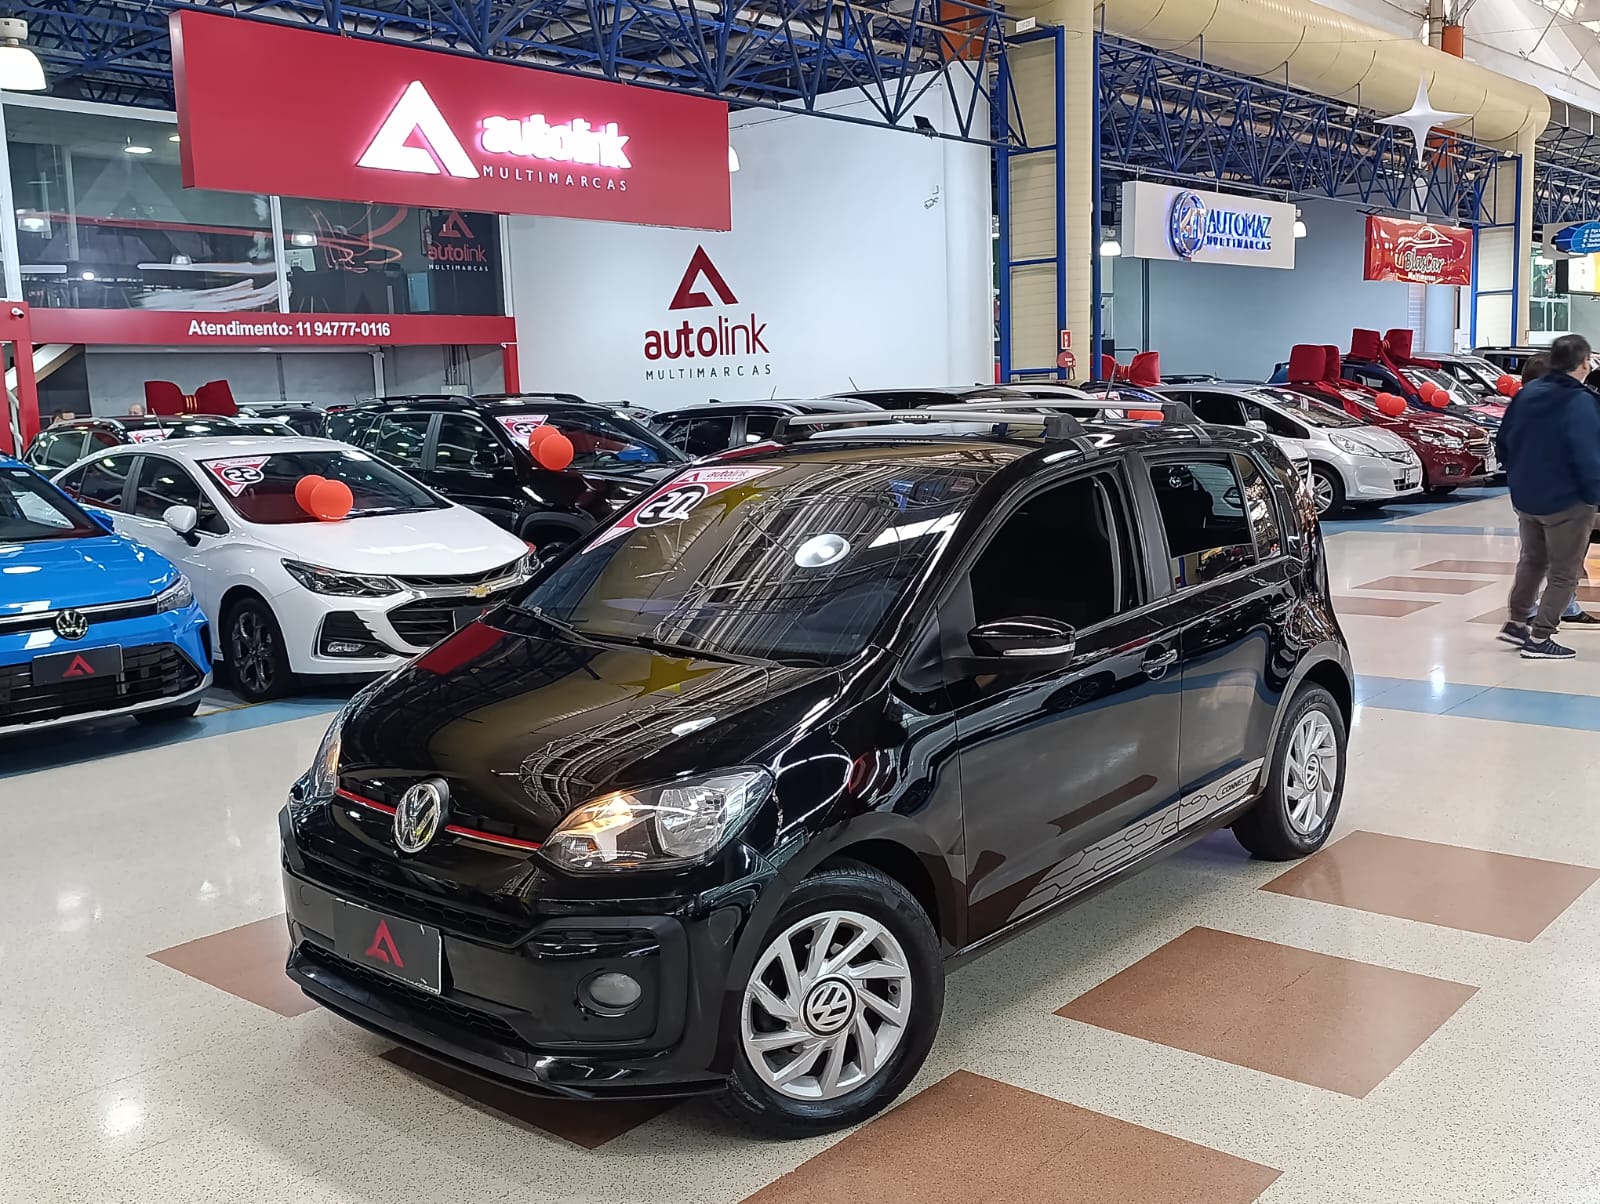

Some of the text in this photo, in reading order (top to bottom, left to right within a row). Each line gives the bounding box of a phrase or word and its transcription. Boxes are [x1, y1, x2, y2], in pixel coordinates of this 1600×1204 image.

[480, 114, 633, 169] autolink
[482, 165, 628, 191] MULTIMARCAS
[1206, 208, 1272, 239] AUTOMAZ
[428, 243, 487, 262] autolink
[1206, 235, 1272, 250] MULTIMARCAS
[428, 263, 489, 272] MULTIMARCAS
[188, 320, 391, 336] Atendimento: 11 94777-0116
[644, 313, 770, 360] autolink
[646, 364, 771, 381] MULTIMARCAS
[639, 491, 699, 519] 20
[1221, 774, 1251, 795] CONNECT
